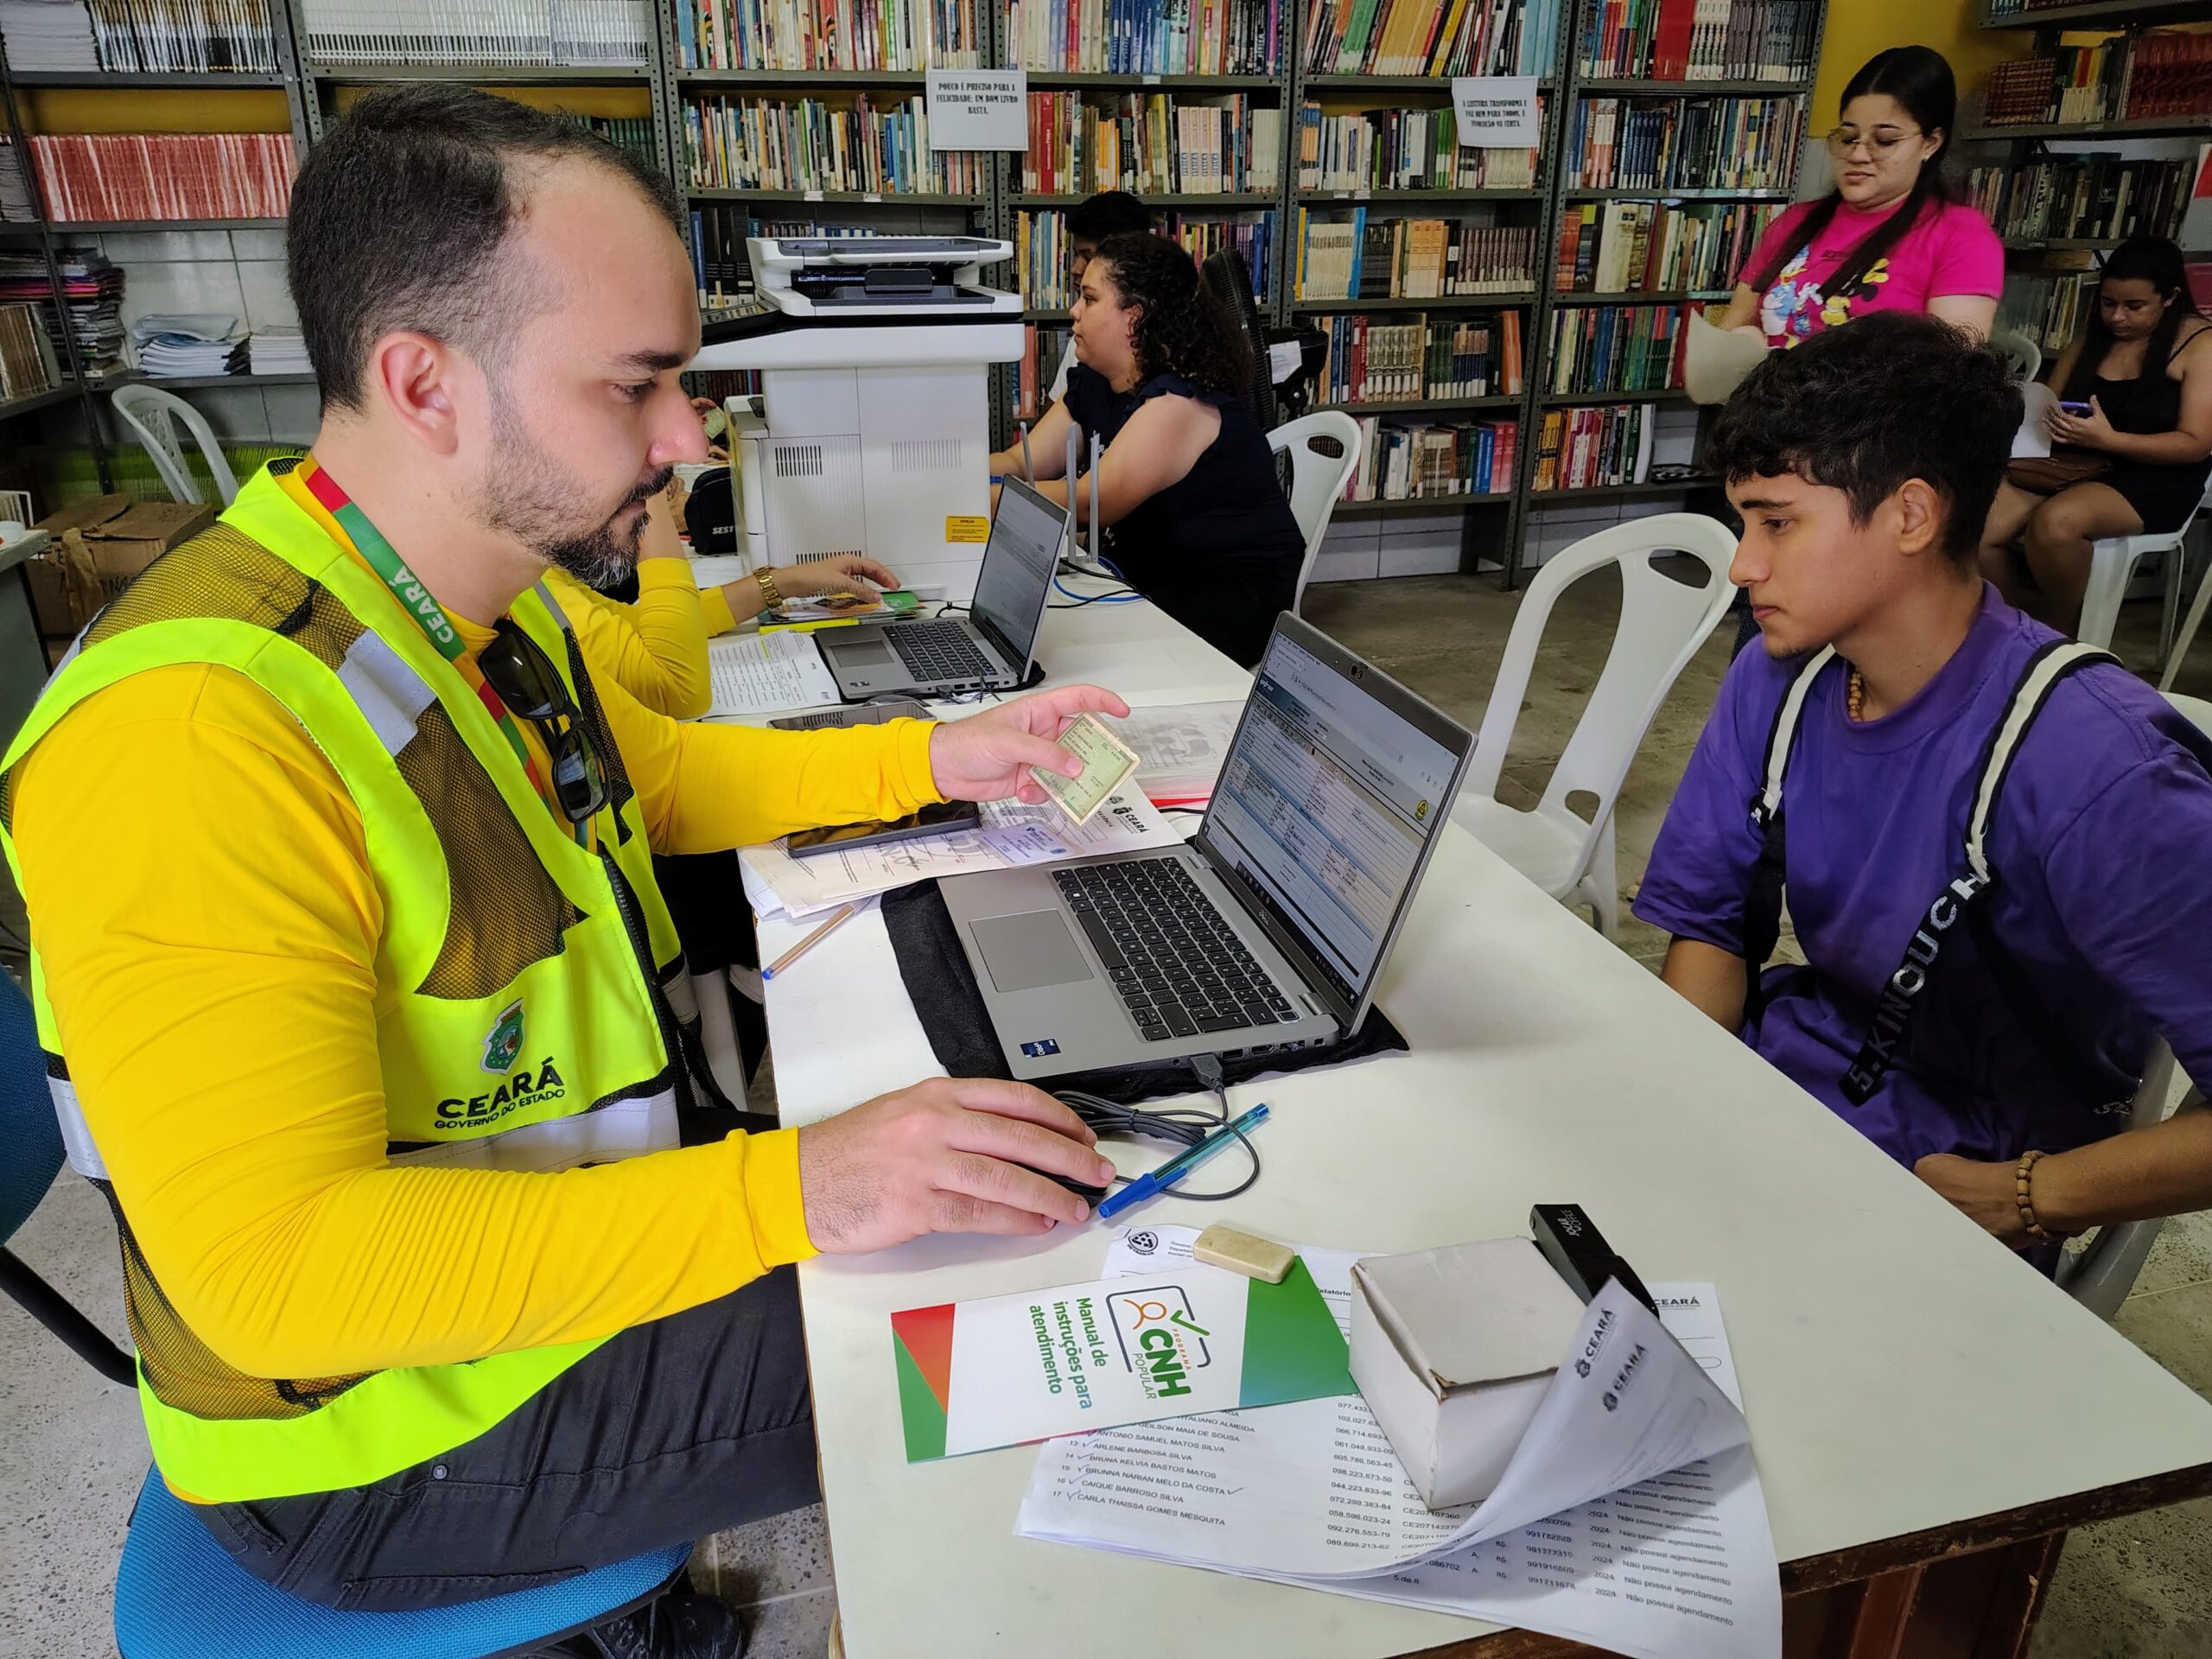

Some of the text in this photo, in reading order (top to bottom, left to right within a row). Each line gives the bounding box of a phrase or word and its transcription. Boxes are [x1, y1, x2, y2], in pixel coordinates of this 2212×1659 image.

[967, 83, 992, 92] PRECISO
[712, 525, 734, 535] SEST
[389, 565, 454, 644] CEARÁ
[436, 1056, 565, 1119] CEARÁ
[434, 1089, 565, 1129] GOVERNO DO ESTADO
[1076, 1297, 1109, 1368] Manual de
[1586, 1307, 1613, 1358] CEARÁ
[1029, 1305, 1063, 1395] atendimento
[1052, 1300, 1093, 1410] instruções para
[1139, 1328, 1192, 1398] CNH
[1172, 1327, 1192, 1371] PROGRAMA
[1132, 1352, 1157, 1400] POPULAR
[1096, 1430, 1225, 1453] ANTONIO SAMUEL MATOS SILVA
[1138, 1422, 1174, 1432] GEILSON
[1175, 1426, 1196, 1435] MAIA
[1211, 1431, 1240, 1442] SOUSA
[1219, 1421, 1255, 1433] ALMEIDA
[1089, 1454, 1119, 1465] BRUNA
[1151, 1462, 1185, 1473] BASTOS
[1186, 1469, 1217, 1479] MATOS
[1092, 1443, 1126, 1452] ARLENE
[1127, 1447, 1167, 1458] BARBOSA
[1168, 1452, 1192, 1462] SILVA
[1081, 1479, 1114, 1491] CAIQUE
[1115, 1485, 1158, 1499] BARROSO
[1160, 1492, 1185, 1503] SILVA
[1085, 1467, 1121, 1478] BRUNNA
[1122, 1471, 1155, 1484] NARIAN
[1156, 1477, 1180, 1488] MELO
[1181, 1481, 1194, 1490] DA
[1195, 1484, 1225, 1496] COSTA
[1077, 1493, 1106, 1504] CARLA
[1108, 1497, 1144, 1511] THAISSA
[1146, 1505, 1179, 1518] GOMES
[1179, 1511, 1226, 1527] MESQUITA
[1660, 1494, 1717, 1507] agendamento
[1662, 1508, 1719, 1522] agendamento
[1589, 1524, 1611, 1534] 2024
[1668, 1538, 1726, 1553] agendamento
[1665, 1522, 1722, 1537] agendamento
[1591, 1540, 1611, 1549] 2024
[1620, 1544, 1639, 1554] Não
[1640, 1548, 1669, 1559] possui
[1669, 1553, 1729, 1568] agendamento
[1592, 1555, 1613, 1565] 2024
[1622, 1560, 1641, 1569] Não
[1642, 1564, 1670, 1575] possui
[1672, 1569, 1732, 1586] agendamento
[1593, 1571, 1615, 1580] 2024
[1624, 1576, 1642, 1586] Não
[1644, 1580, 1673, 1592] possui
[1674, 1586, 1733, 1606] agendamento
[1595, 1587, 1617, 1598] 2024
[1625, 1592, 1644, 1604] Não
[1646, 1598, 1675, 1611] possui
[1676, 1605, 1734, 1627] agendamento
